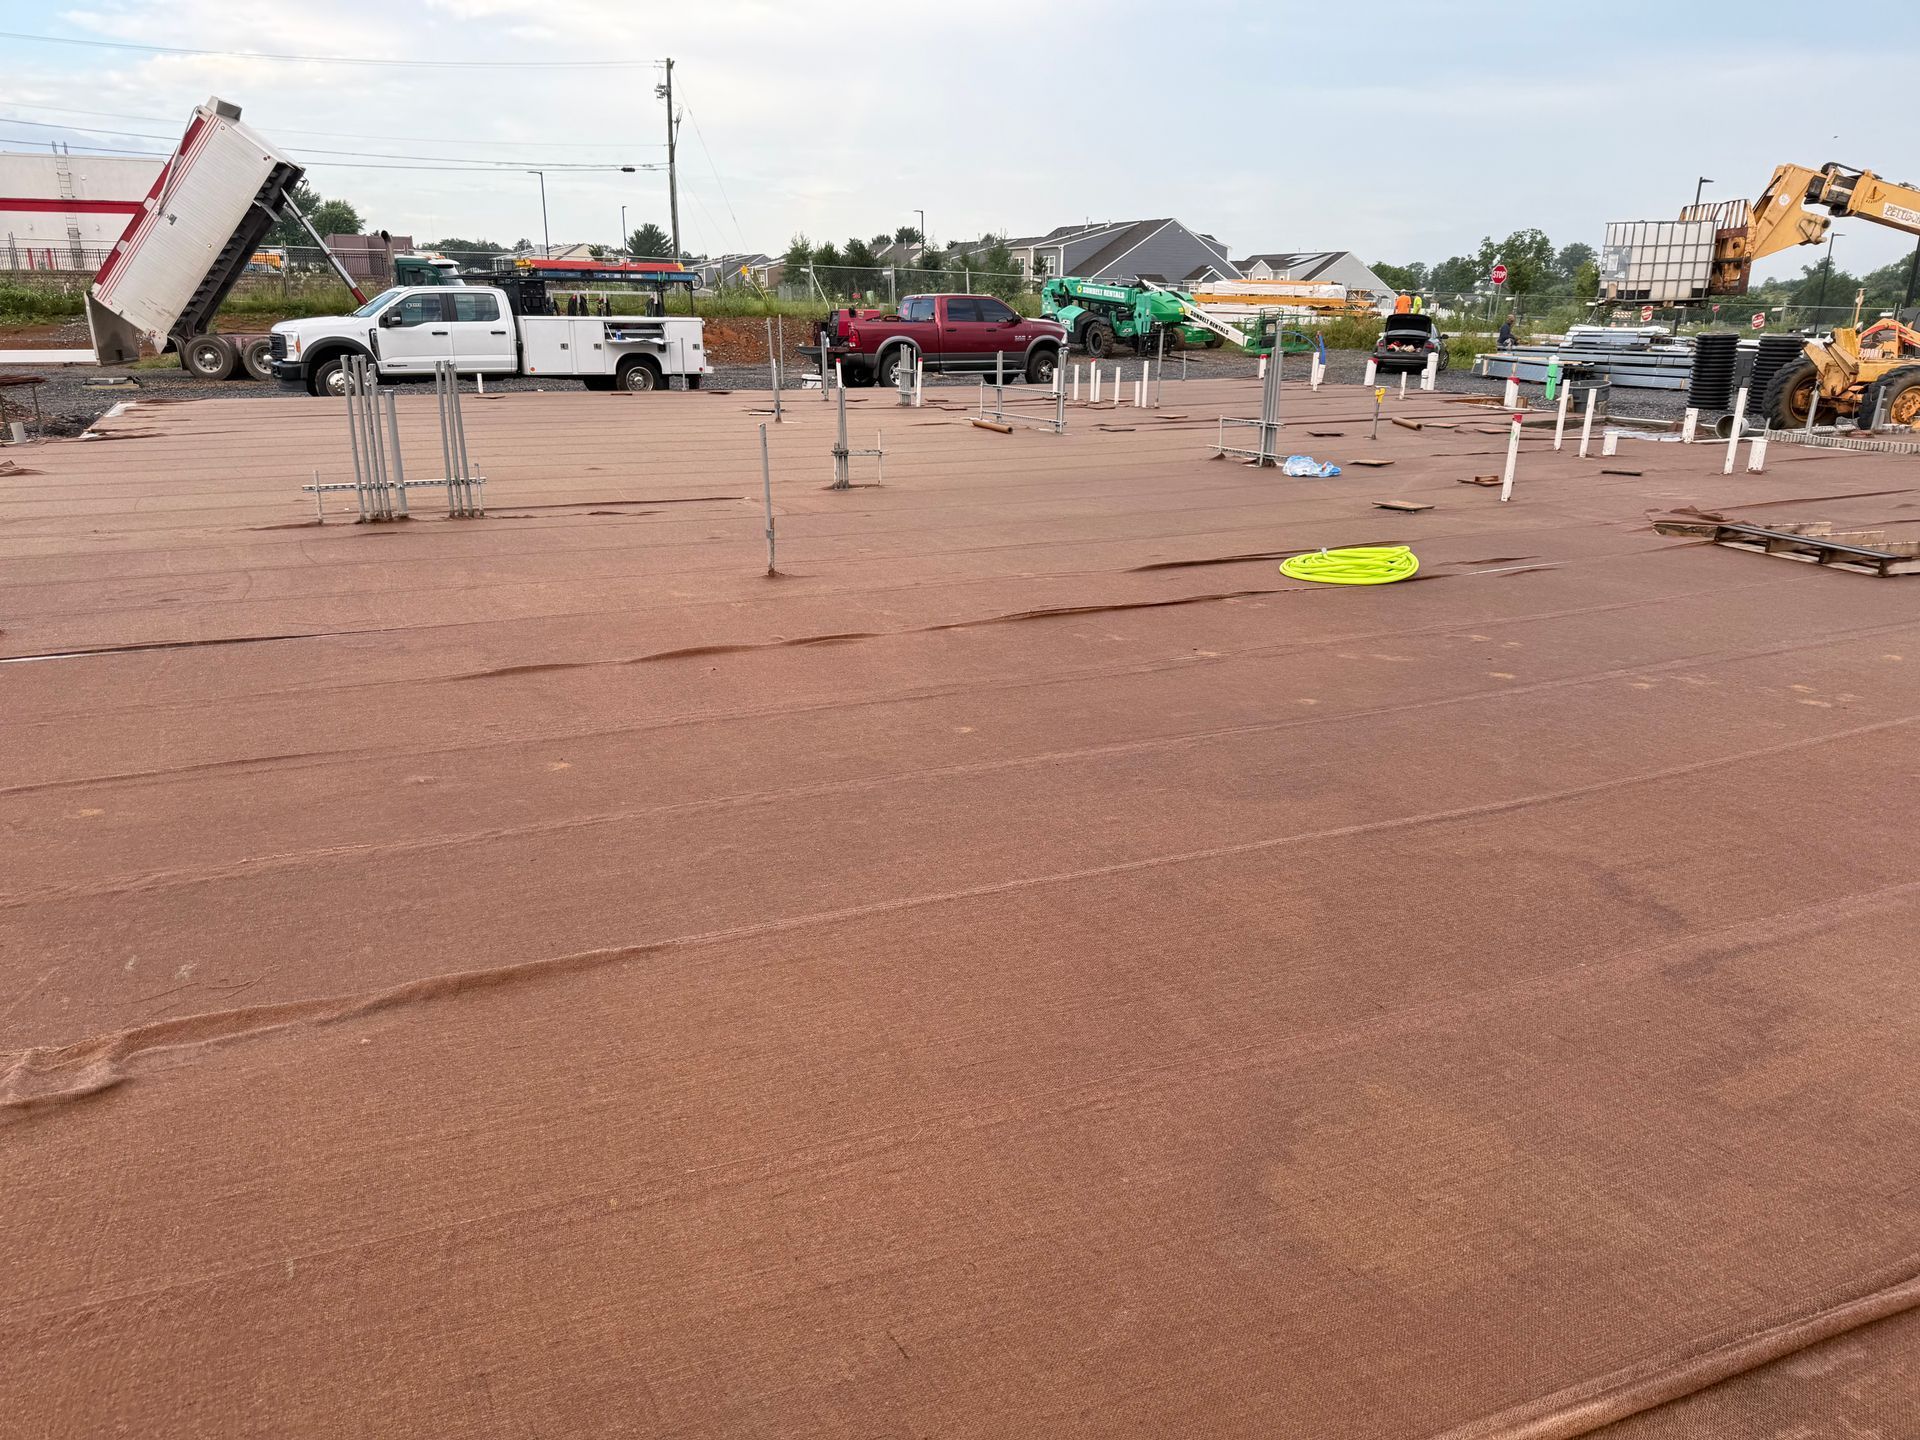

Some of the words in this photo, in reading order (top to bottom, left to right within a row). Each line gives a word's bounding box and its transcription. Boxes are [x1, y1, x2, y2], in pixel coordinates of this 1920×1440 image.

[1492, 270, 1506, 279] STOP
[1083, 287, 1102, 295] SUNBELT
[1103, 290, 1125, 298] RENTALS
[1190, 310, 1209, 324] SUNBELT
[1209, 321, 1230, 335] RENTALS
